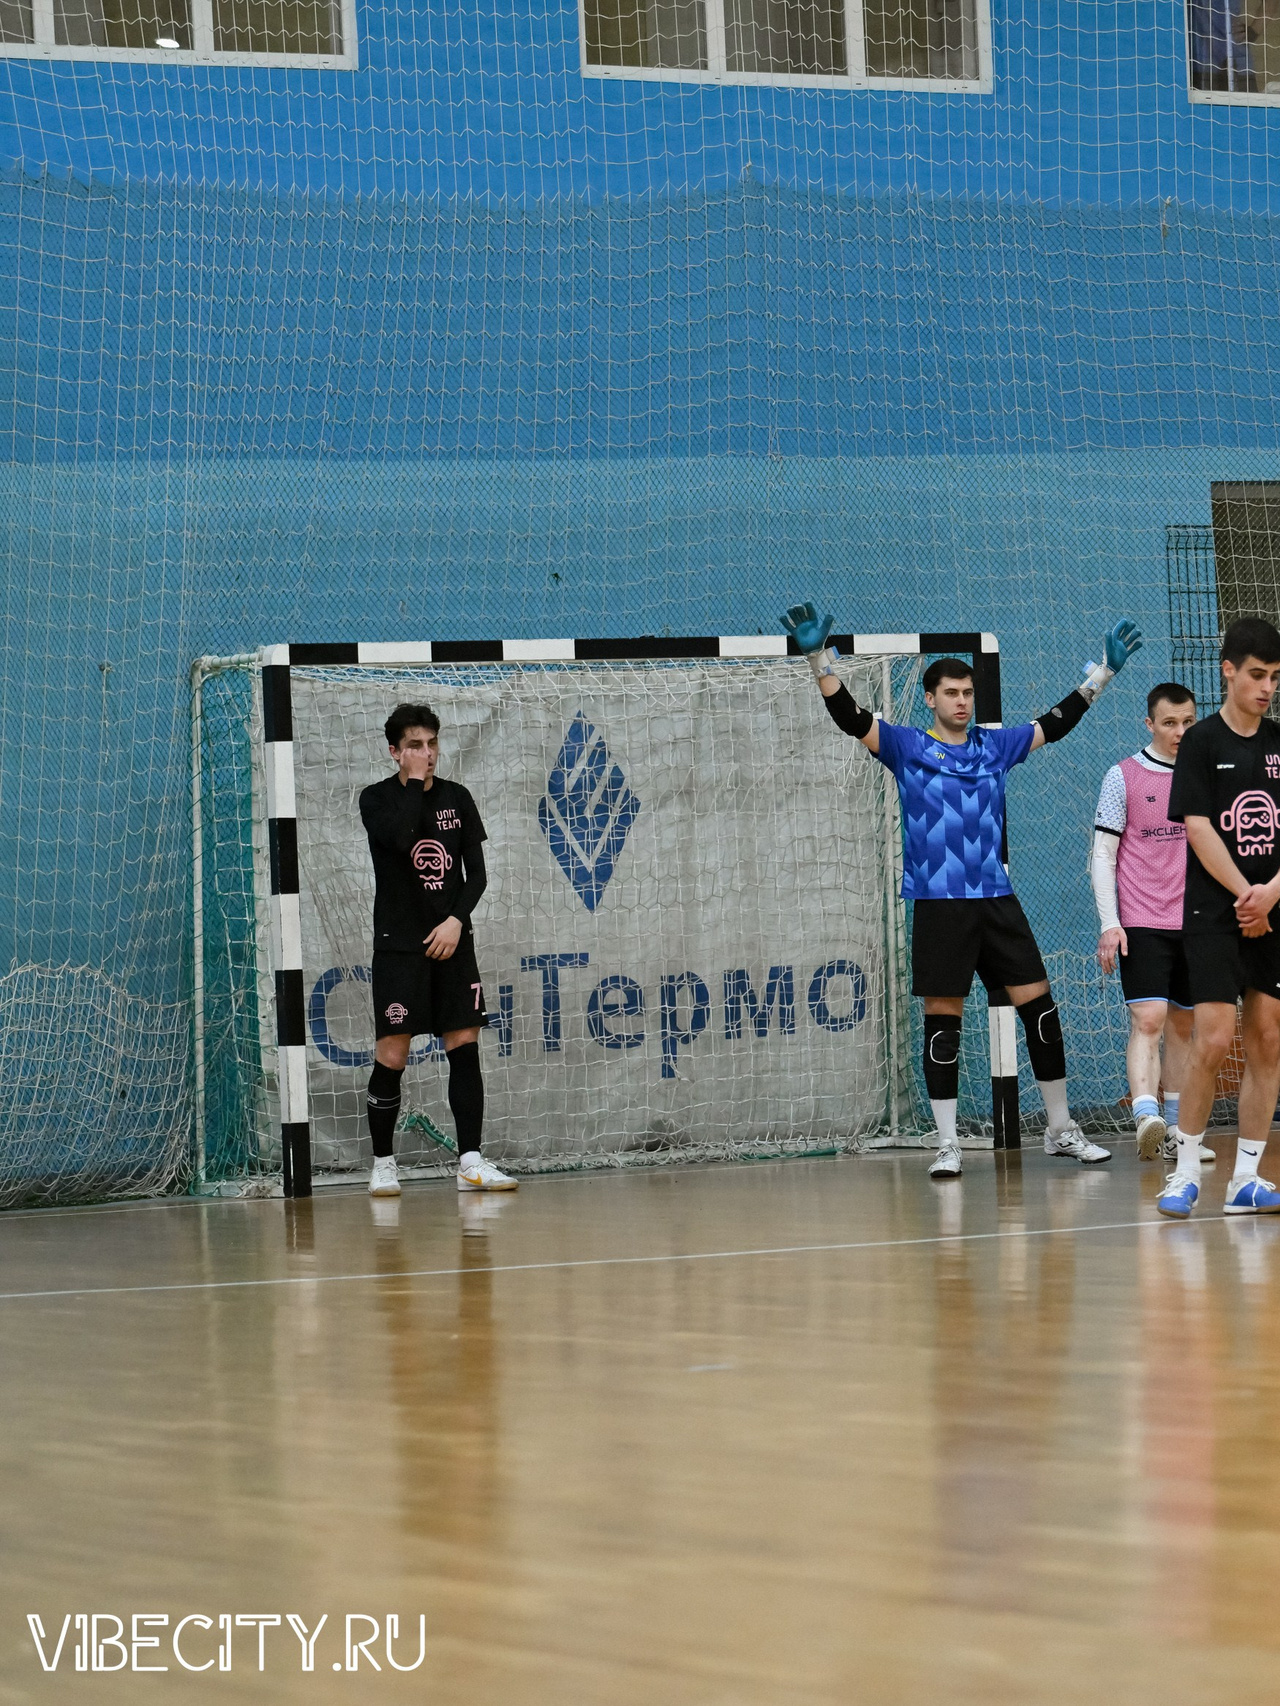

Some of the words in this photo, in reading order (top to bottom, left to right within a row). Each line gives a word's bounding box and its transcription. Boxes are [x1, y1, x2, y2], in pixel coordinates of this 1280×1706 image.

[436, 809, 456, 820] UNIT
[436, 819, 462, 831] TEAM
[1237, 843, 1275, 857] UNIT
[308, 952, 868, 1079] СнТермо
